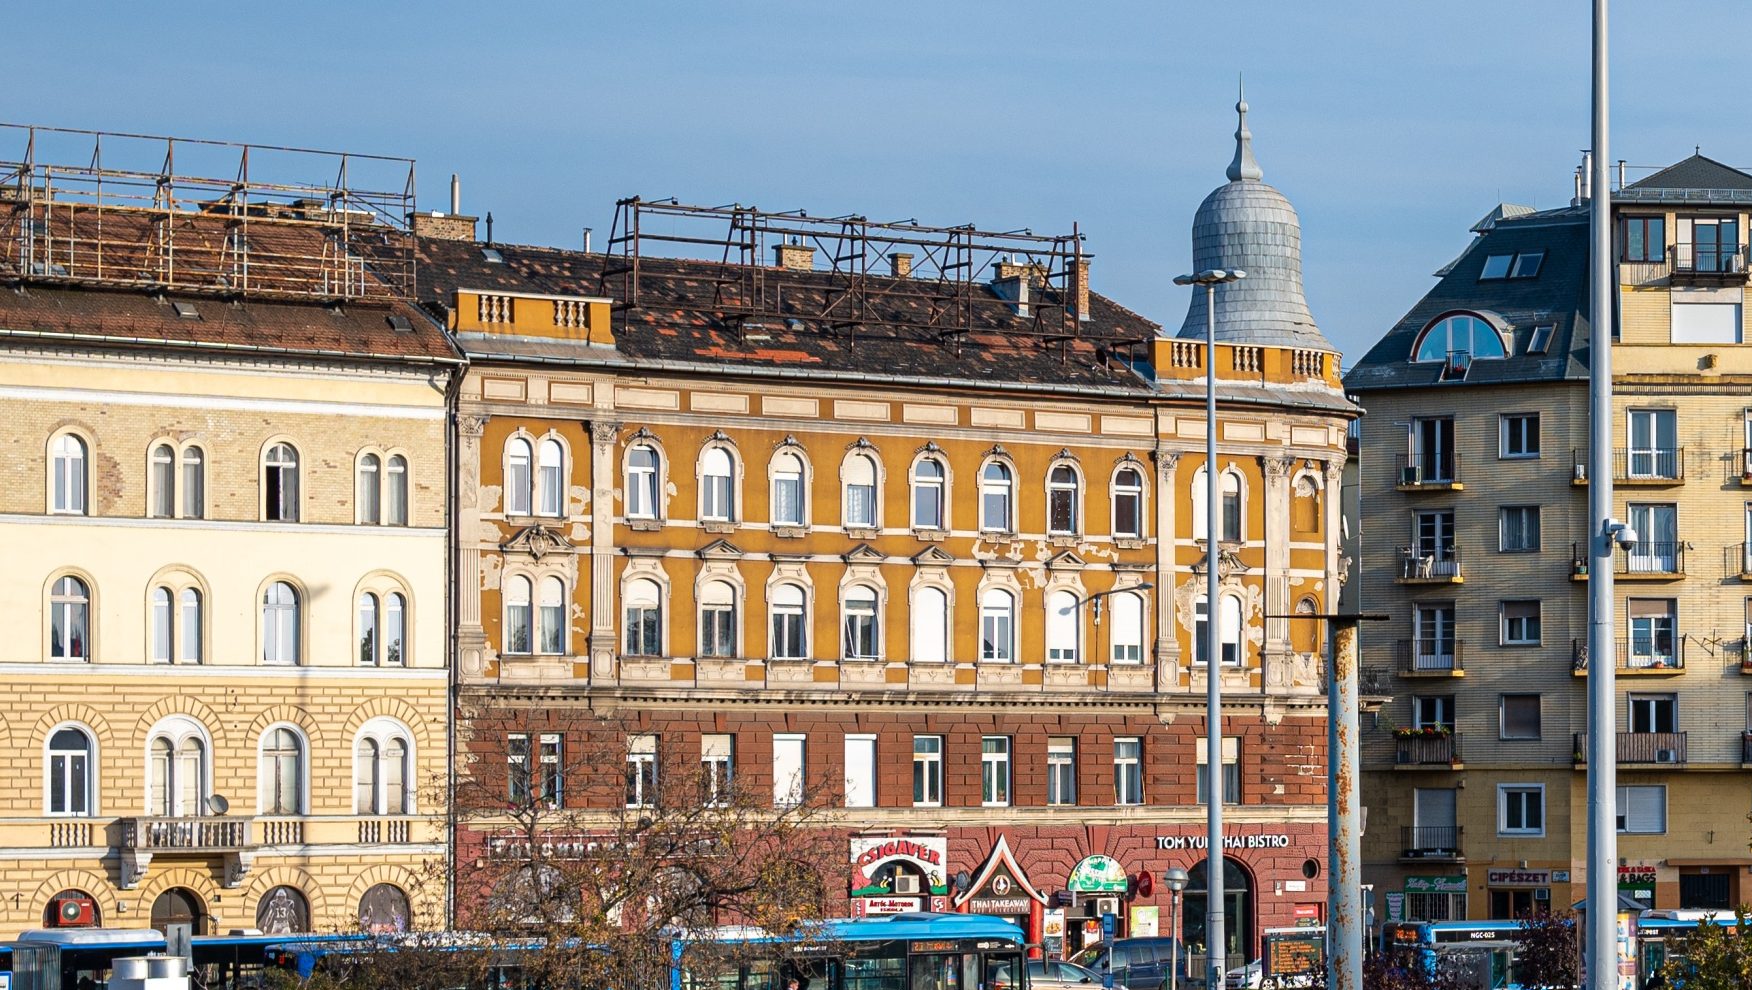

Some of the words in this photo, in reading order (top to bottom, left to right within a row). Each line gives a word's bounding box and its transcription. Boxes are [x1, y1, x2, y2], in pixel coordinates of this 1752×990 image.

[1157, 836, 1185, 849] TOM
[1222, 836, 1245, 848] HAI
[1248, 835, 1289, 848] BISTRO
[857, 840, 940, 866] CSIGAVÉR
[1489, 869, 1548, 883] CIPÉSZET
[1629, 873, 1656, 882] BAGS
[972, 900, 990, 908] THAI
[991, 899, 1028, 907] TAKEAWAY
[275, 907, 286, 918] 13
[1471, 931, 1496, 939] NGC-025
